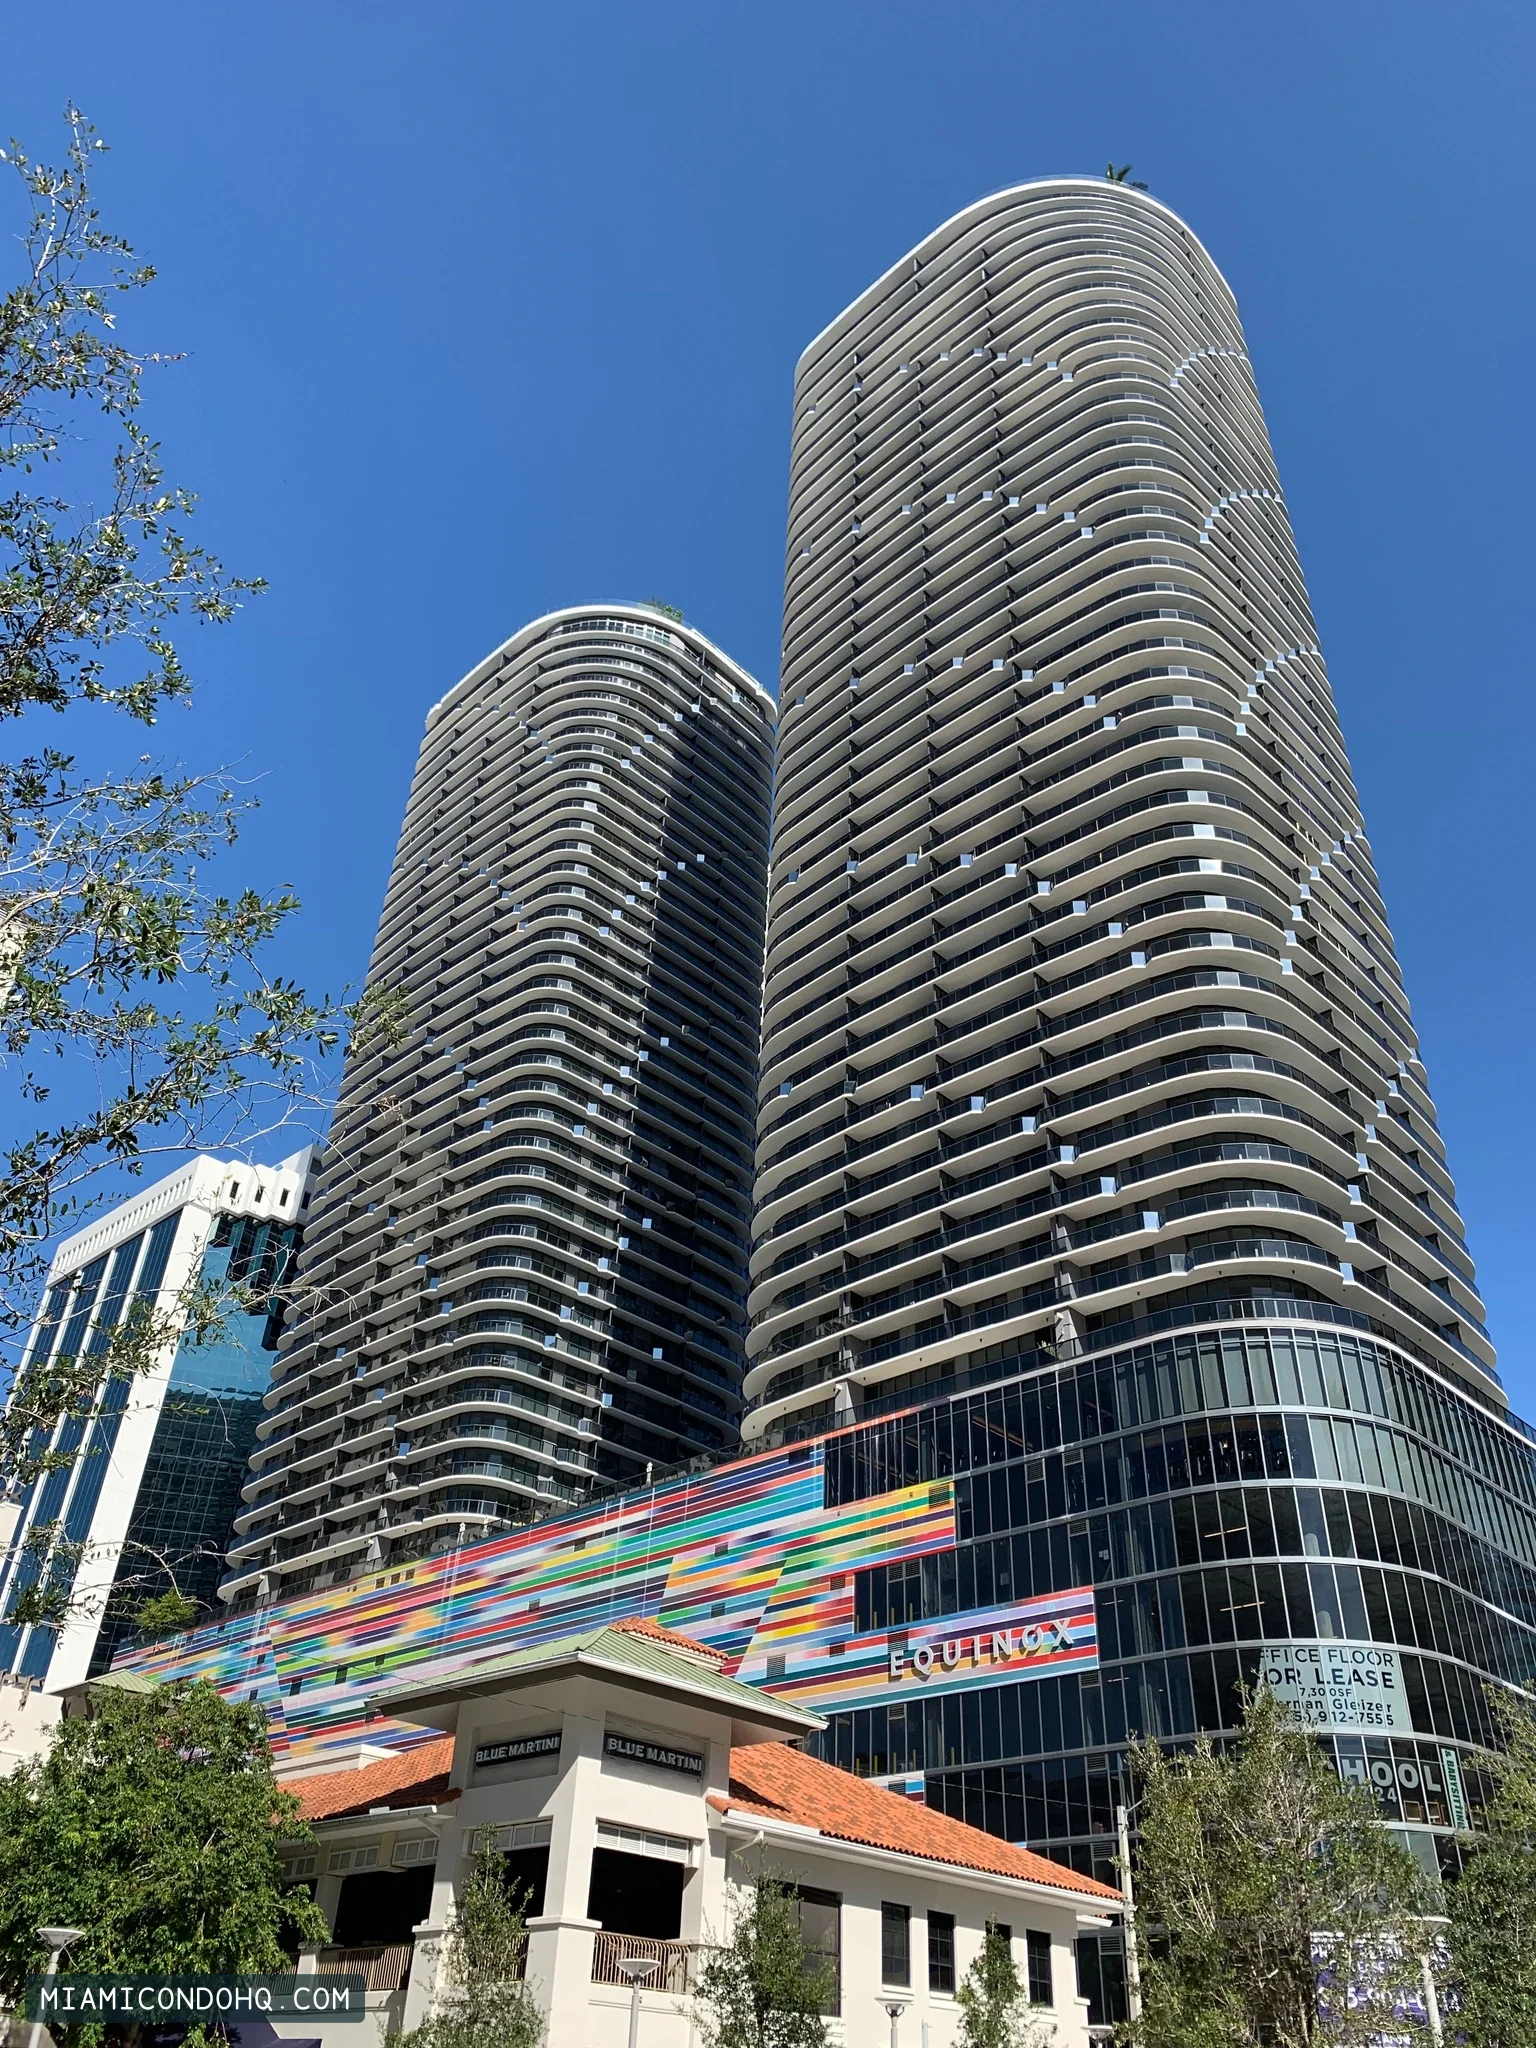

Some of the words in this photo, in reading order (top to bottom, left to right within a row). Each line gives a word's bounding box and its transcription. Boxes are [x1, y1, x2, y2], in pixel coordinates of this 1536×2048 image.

[890, 1618, 1076, 1677] EQUINOX
[1327, 1649, 1395, 1668] FLOOR
[1264, 1668, 1303, 1685] OR
[1316, 1668, 1395, 1689] LEASE
[1333, 1698, 1392, 1713] Gleizer
[475, 1746, 507, 1763] BLUE
[508, 1736, 560, 1757] MARTINI
[607, 1737, 644, 1758] BLUE
[646, 1748, 702, 1772] MARTINI
[1327, 1759, 1442, 1793] HOOL
